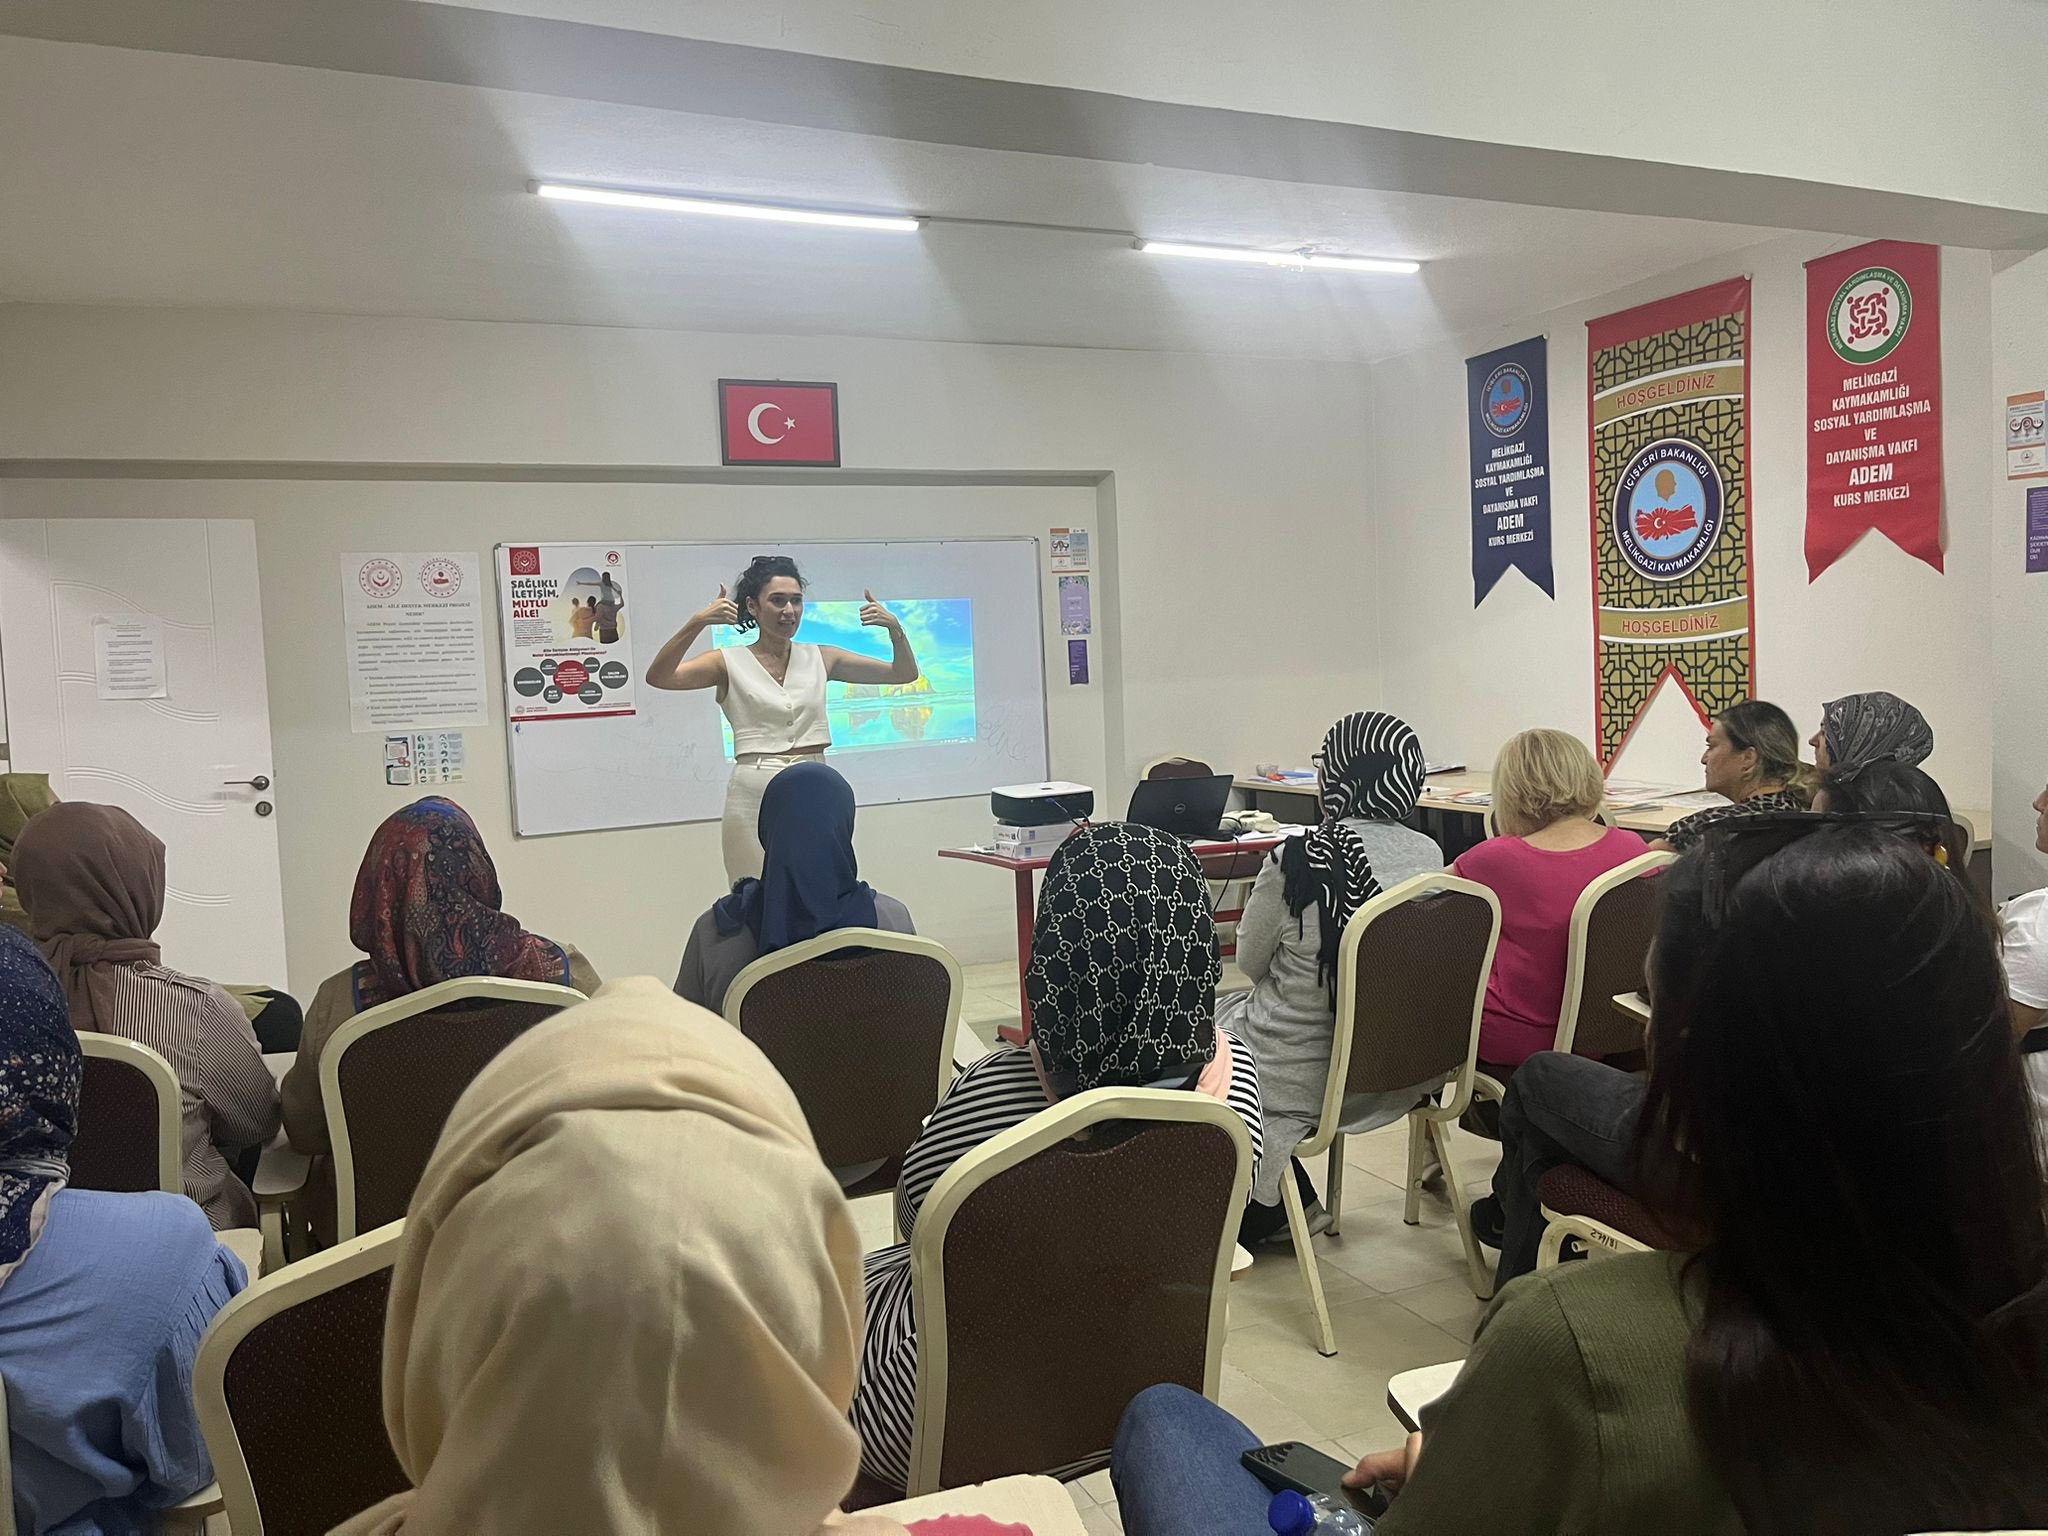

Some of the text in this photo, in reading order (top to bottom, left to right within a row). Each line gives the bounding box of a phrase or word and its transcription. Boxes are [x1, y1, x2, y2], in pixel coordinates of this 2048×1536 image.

[1843, 366, 1898, 392] MELİKGAZİ
[1616, 371, 1716, 409] HOŞGELDİNİZ
[1832, 383, 1910, 411] KAYMAKAMLIĞI
[1814, 400, 1931, 432] SOSYAL YARDIMLAŞMA
[1864, 427, 1877, 441] VE
[1491, 440, 1525, 459] MELİKGAZİ
[1826, 438, 1918, 465] DAYANIŞMA VAKFI
[1485, 454, 1533, 473] KAYMAKAMLIĞI
[1623, 448, 1710, 491] İÇİŞLERİ BAKANLIĞI
[1849, 462, 1893, 486] ADEM
[1475, 466, 1545, 489] SOSYAL YARDIMLAŞMA
[1505, 486, 1514, 497] VE
[1833, 483, 1910, 507] KURS MERKEZİ
[1482, 495, 1538, 514] DAYANIŞMA VAKFI
[1497, 513, 1524, 531] ADEM
[1488, 529, 1534, 547] KURS MERKEZİ
[1621, 519, 1715, 572] MELİKGAZİ KAYMAKAMLIĞI
[511, 578, 558, 588] SAĞLIKLI
[512, 587, 559, 600] İLETİŞİM,
[513, 600, 548, 608] MUTLU
[514, 608, 539, 618] AİLE!
[1621, 611, 1719, 636] HOŞGELDİNİZ
